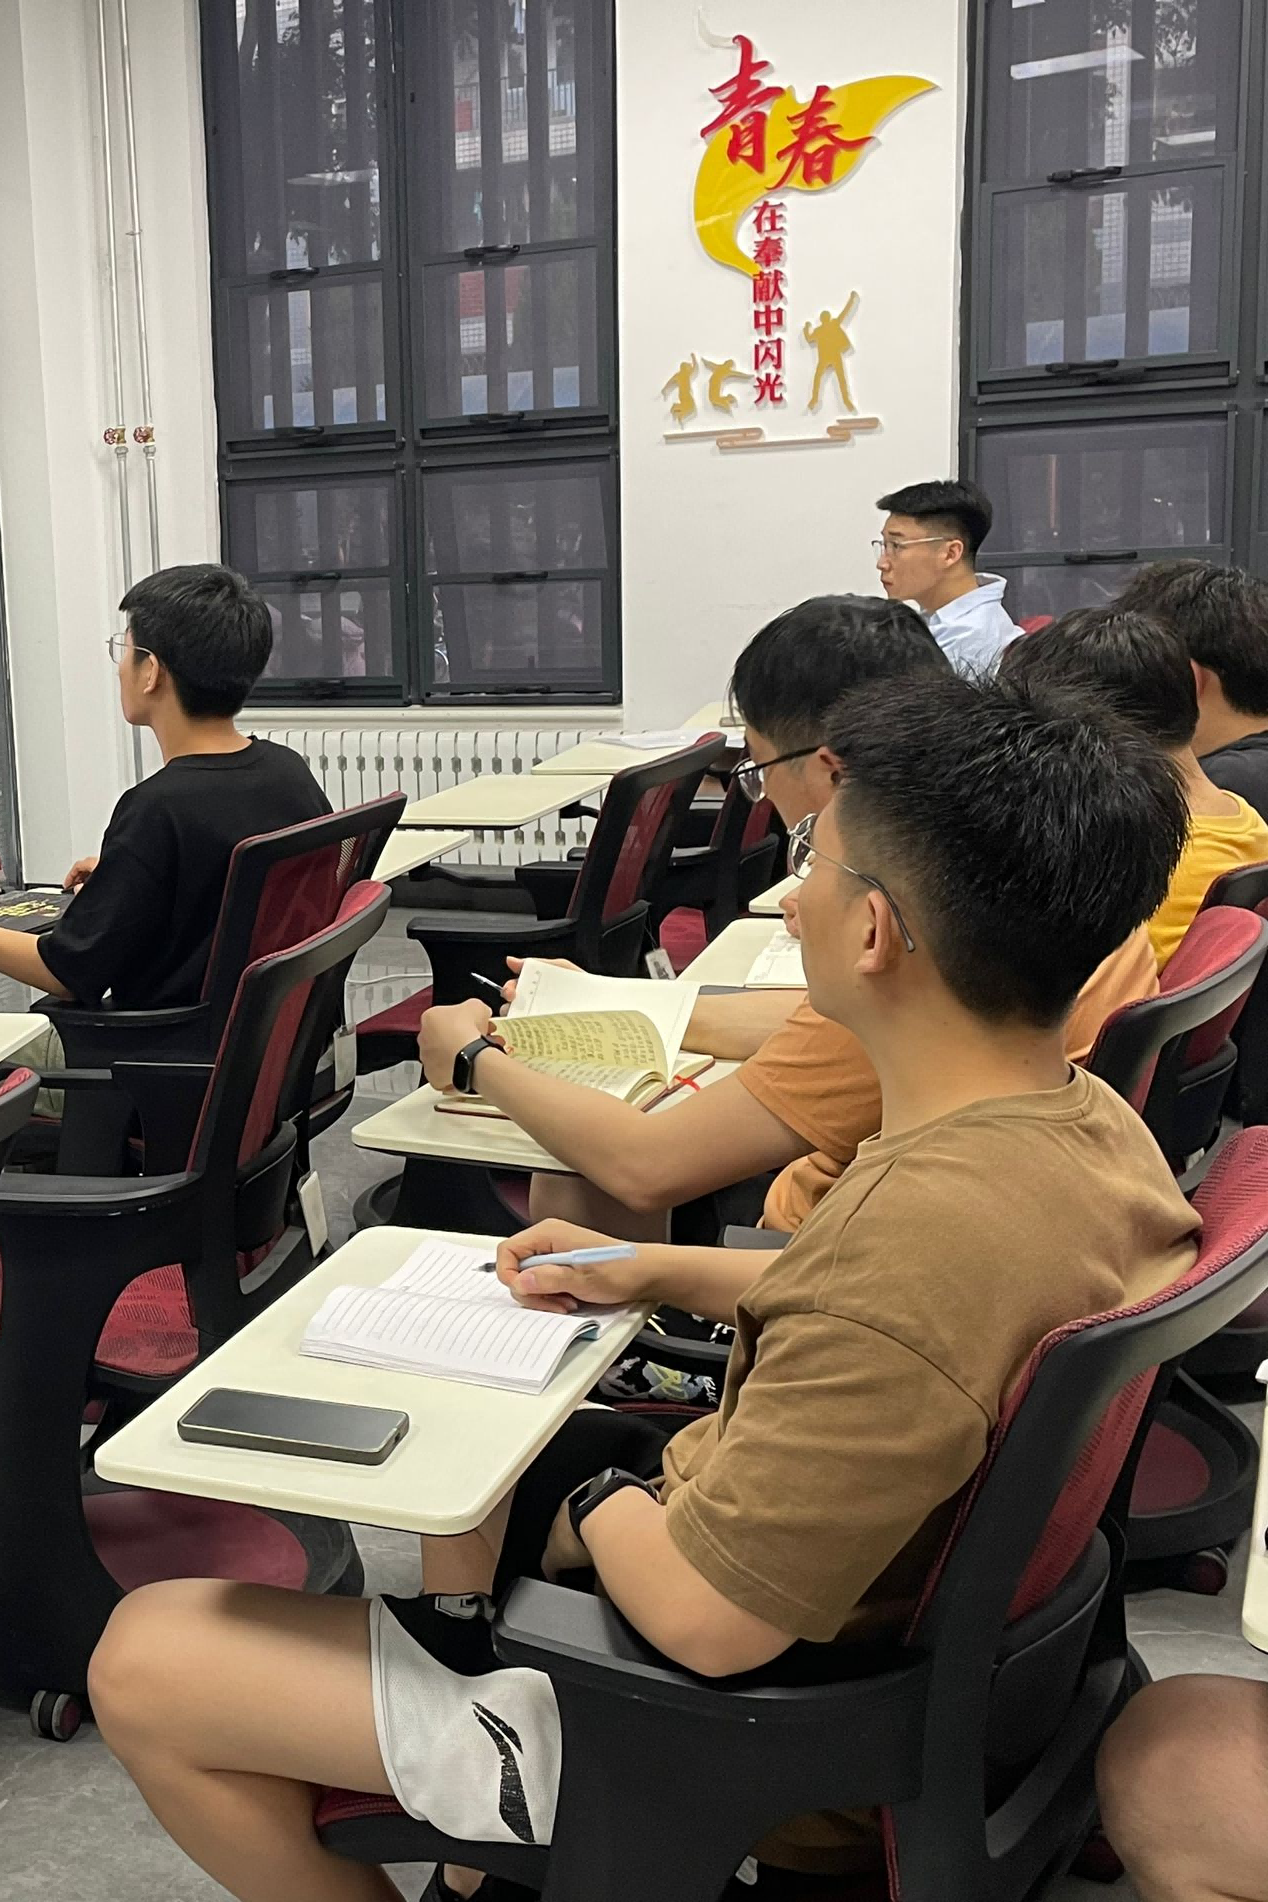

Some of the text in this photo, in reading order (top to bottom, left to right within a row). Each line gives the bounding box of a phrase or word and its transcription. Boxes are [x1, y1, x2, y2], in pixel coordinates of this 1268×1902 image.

[700, 34, 874, 191] 青春
[752, 200, 785, 404] 在奉献中闪光
